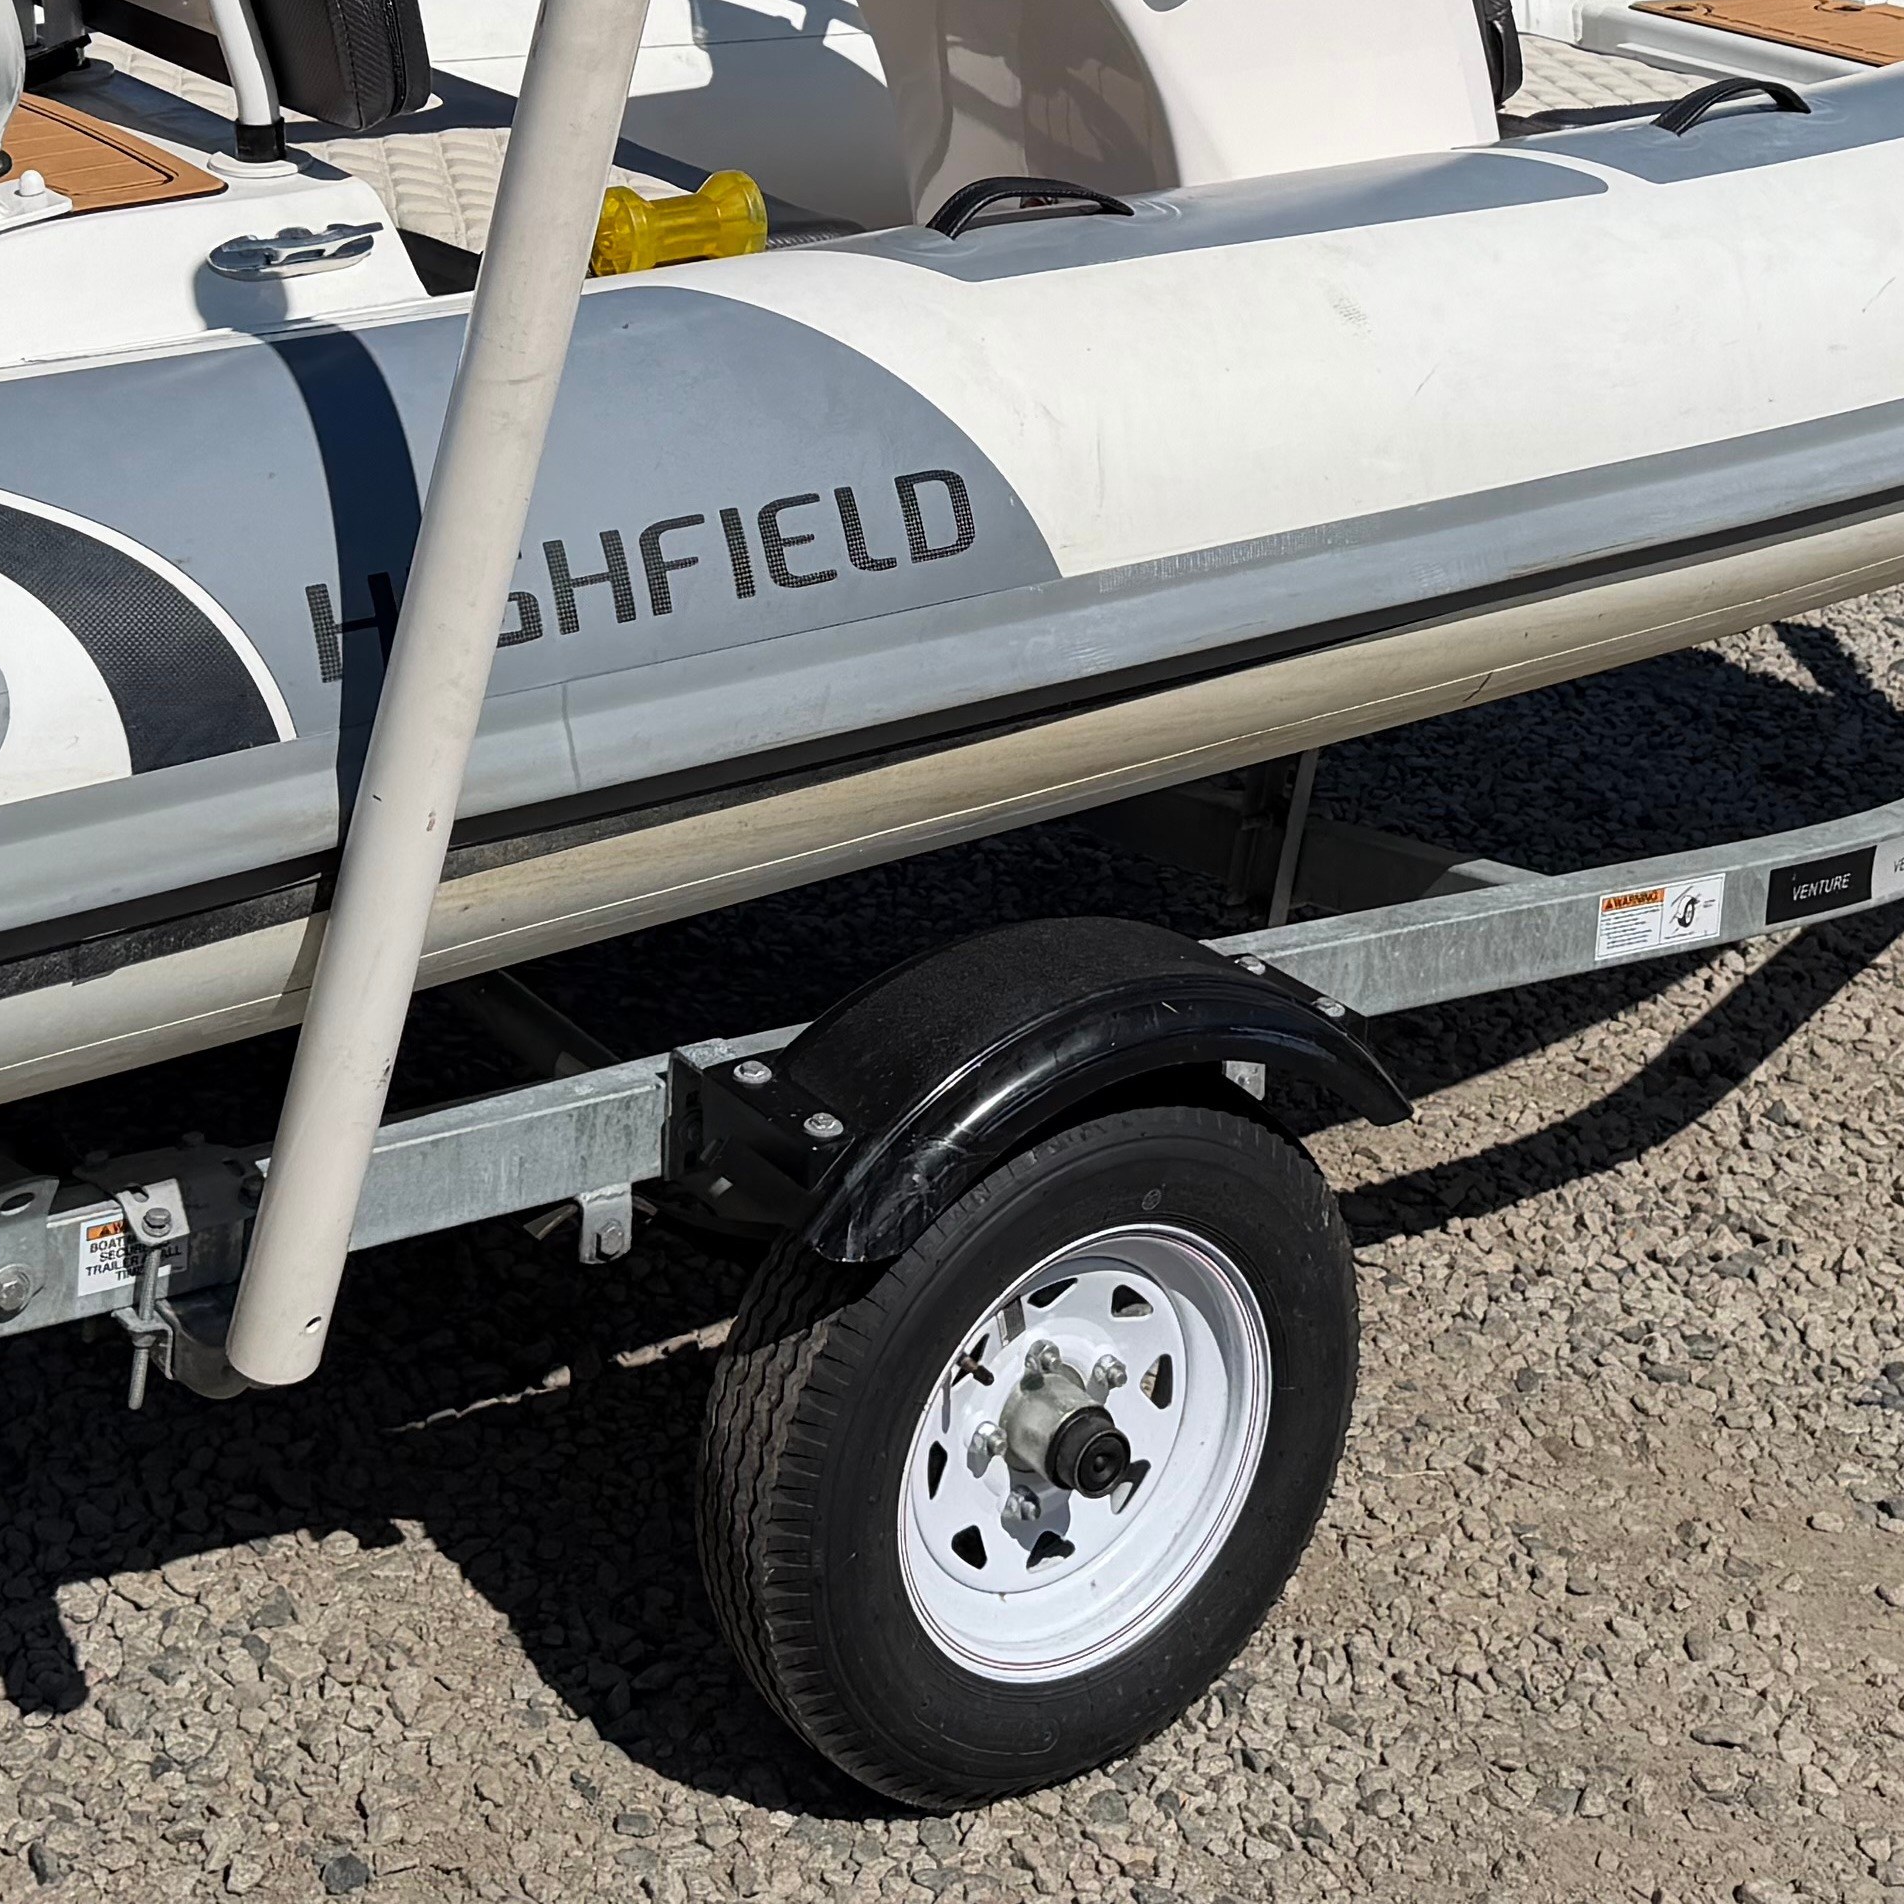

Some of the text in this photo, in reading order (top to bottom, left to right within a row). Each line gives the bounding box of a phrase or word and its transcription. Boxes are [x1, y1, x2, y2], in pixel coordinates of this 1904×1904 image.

[305, 469, 975, 683] HHFIELD
[1792, 872, 1852, 901] VENTURE
[89, 1237, 124, 1254] BOAT
[99, 1242, 154, 1263] SECURE
[85, 1254, 139, 1276] TRAILER
